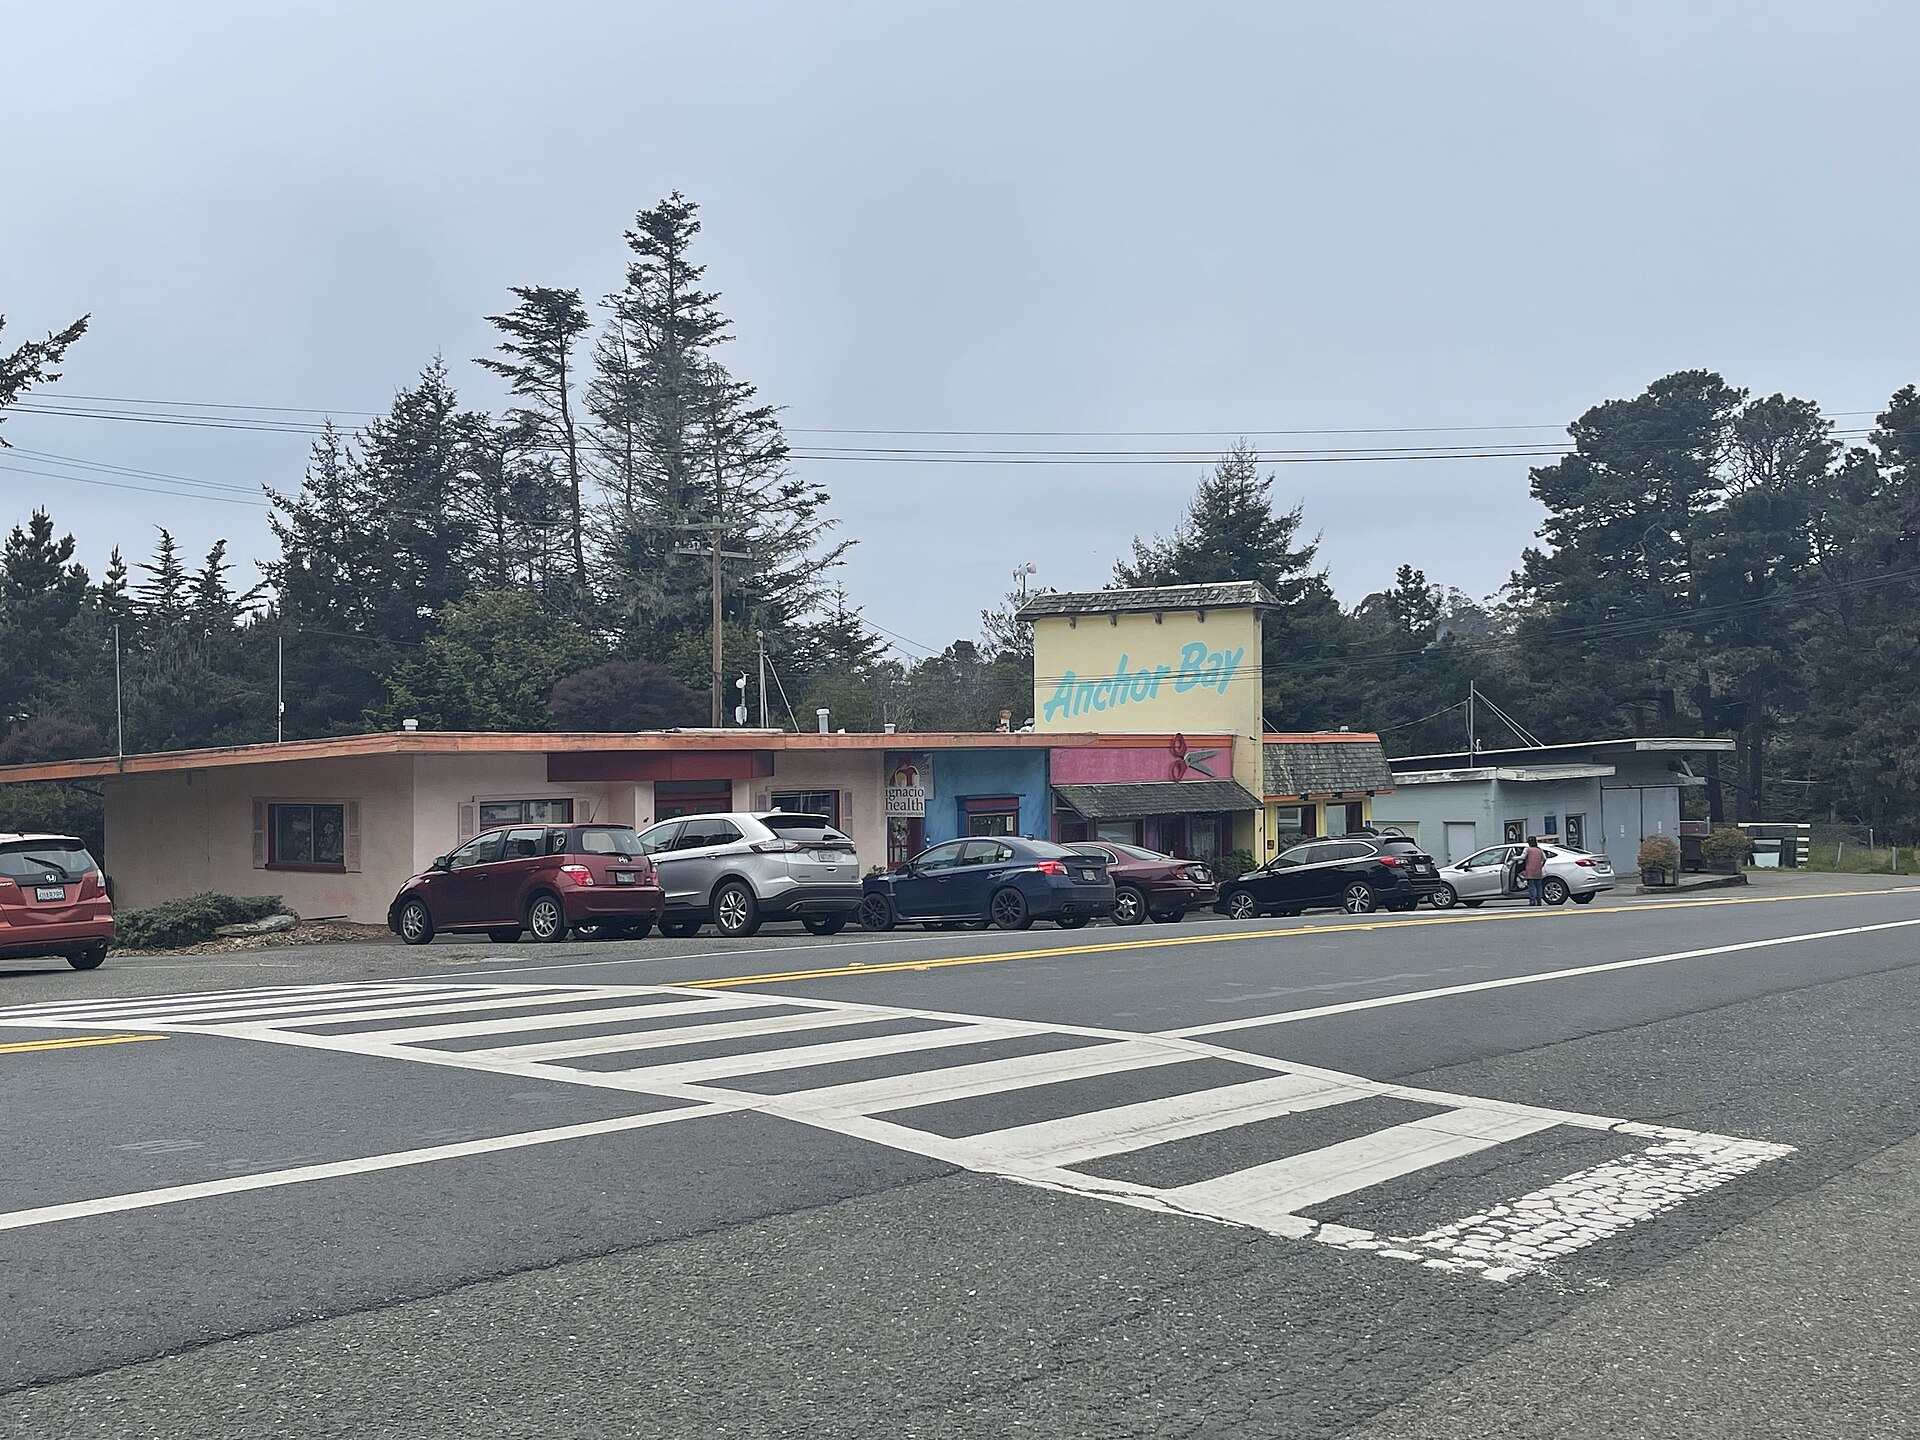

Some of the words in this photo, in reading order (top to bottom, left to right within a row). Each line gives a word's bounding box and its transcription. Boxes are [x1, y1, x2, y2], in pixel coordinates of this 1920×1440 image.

[1043, 653, 1172, 723] Anchor
[1174, 641, 1245, 695] Bay
[885, 786, 924, 801] ignacio
[885, 798, 924, 811] health
